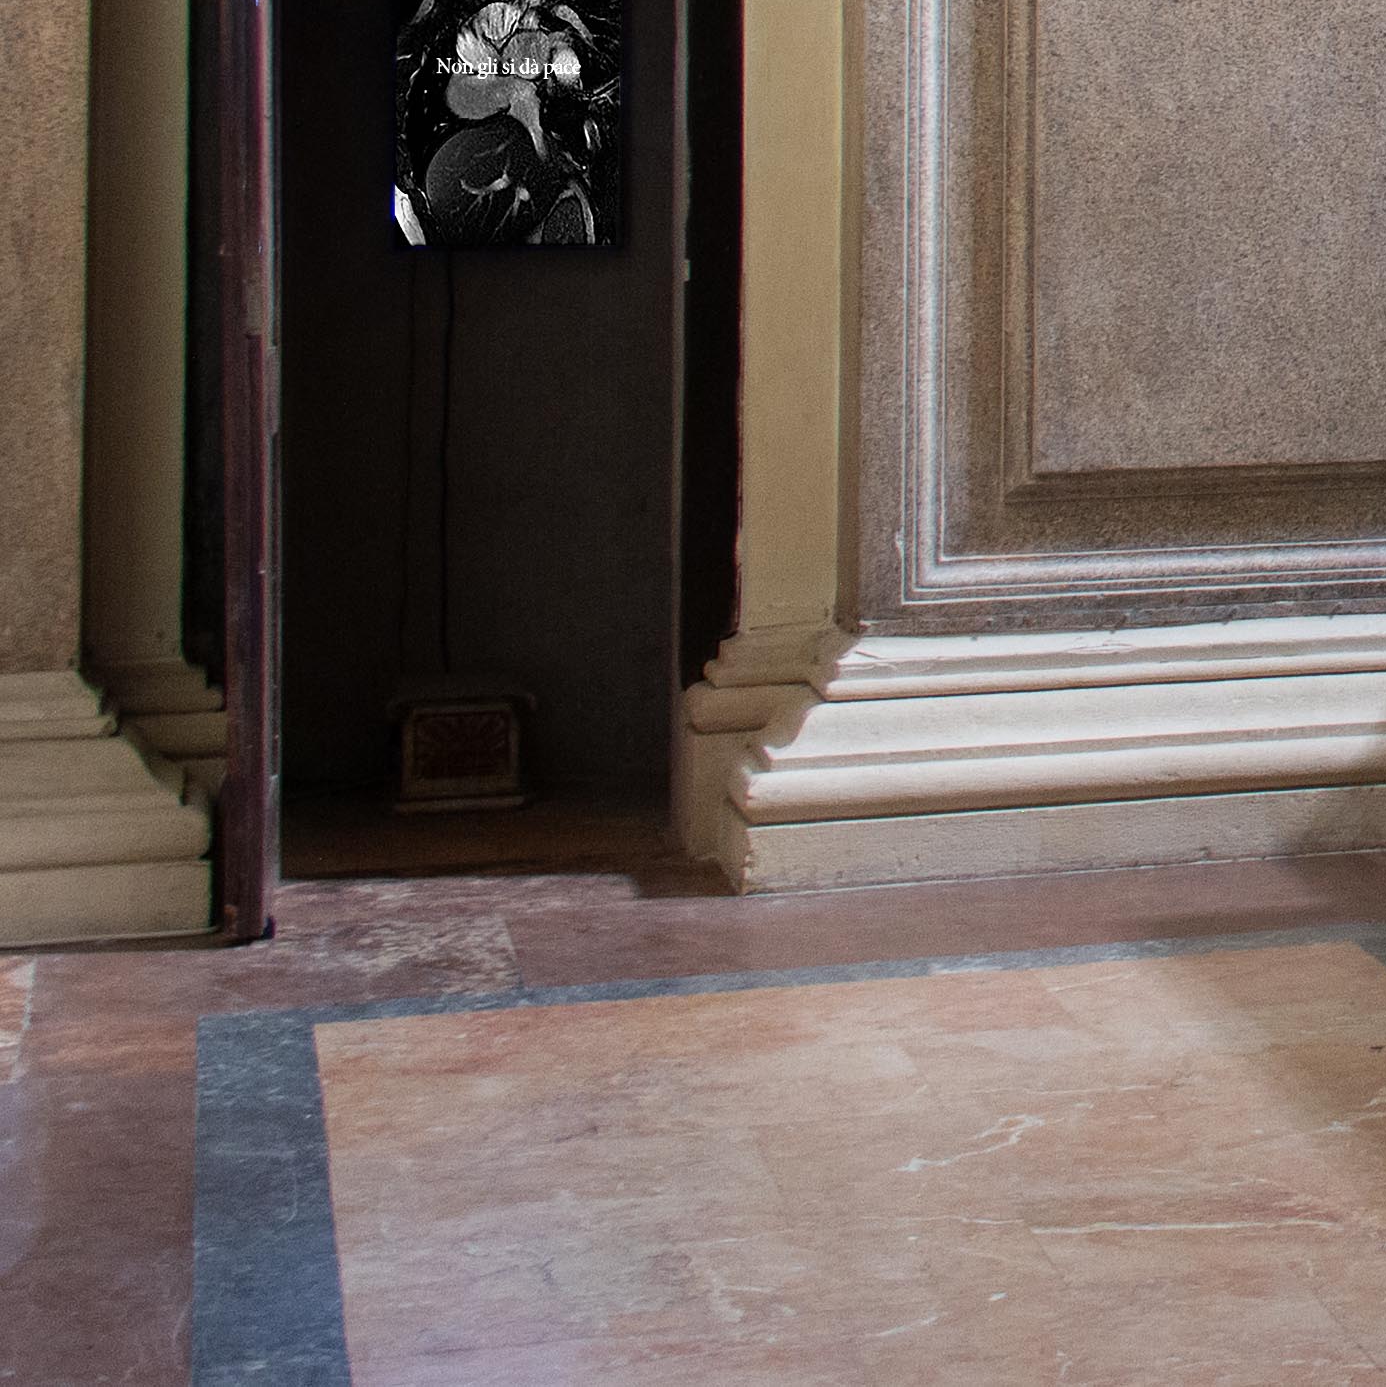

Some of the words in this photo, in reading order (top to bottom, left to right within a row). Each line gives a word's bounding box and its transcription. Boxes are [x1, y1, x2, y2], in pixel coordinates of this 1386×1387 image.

[477, 57, 499, 80] gli
[501, 58, 516, 75] si
[519, 57, 541, 75] dà
[543, 63, 582, 80] pace
